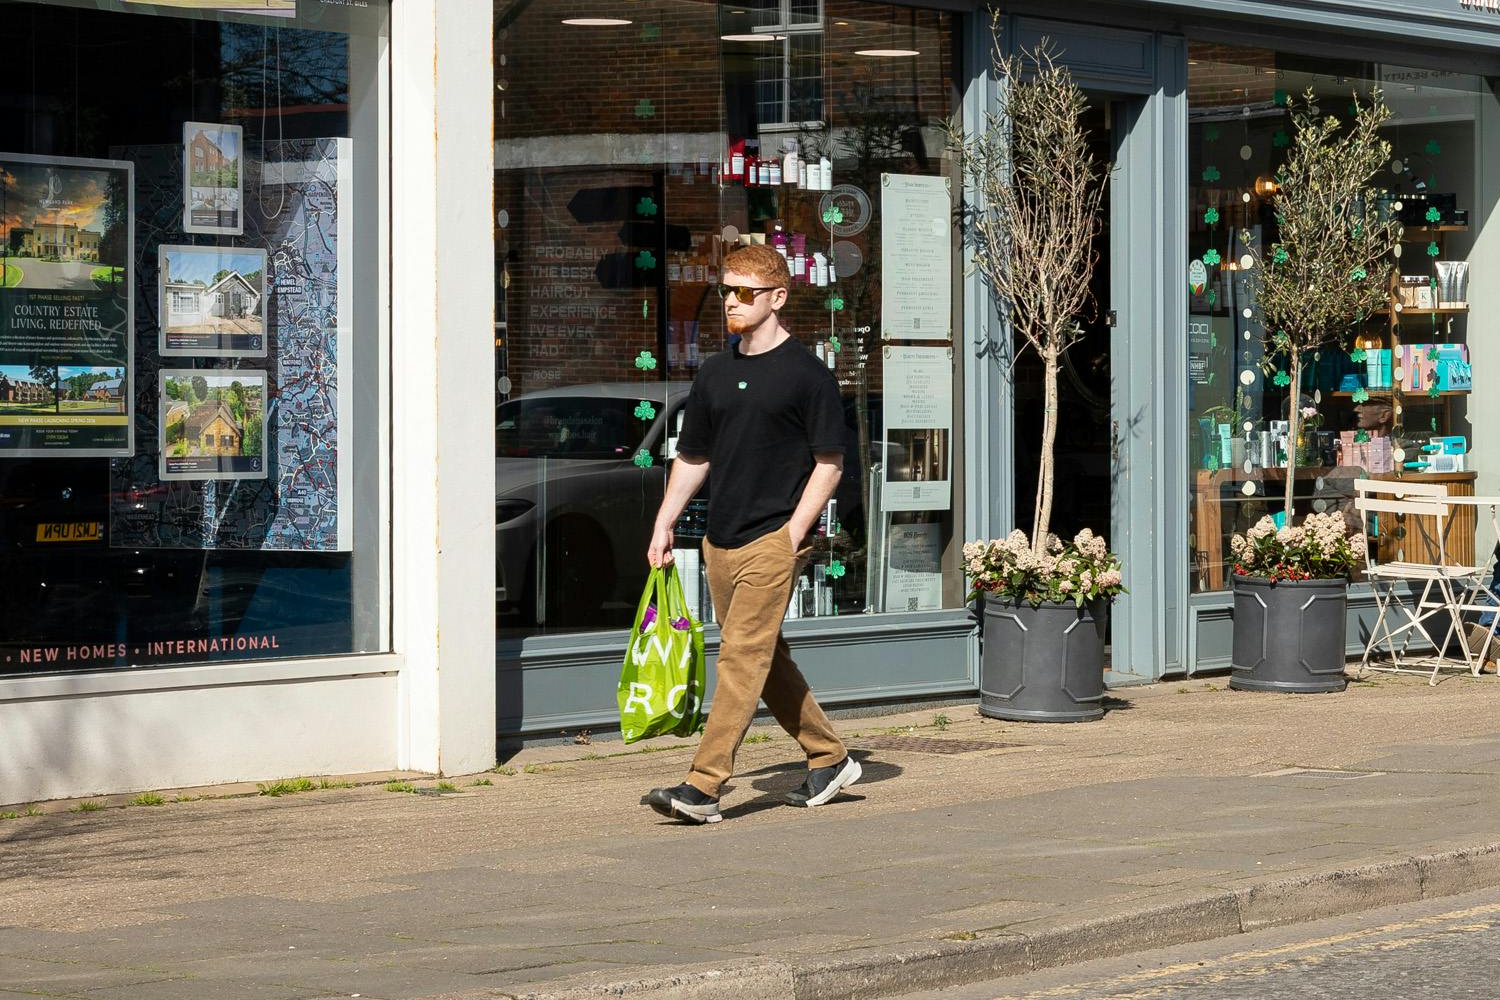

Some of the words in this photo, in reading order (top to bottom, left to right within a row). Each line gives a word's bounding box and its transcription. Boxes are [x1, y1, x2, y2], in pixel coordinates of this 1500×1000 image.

[561, 266, 596, 278] BEST
[530, 287, 591, 298] HAIRCUT
[14, 305, 61, 316] COUNTRY
[63, 305, 99, 318] ESTATE
[530, 305, 616, 318] EXPERIENCE
[11, 318, 47, 330] LIVING,
[49, 318, 102, 331] REDEFINED
[562, 326, 594, 338] EVER
[20, 647, 59, 663] NEW
[67, 643, 127, 660] HOMES
[148, 635, 280, 656] INTERNATIONAL
